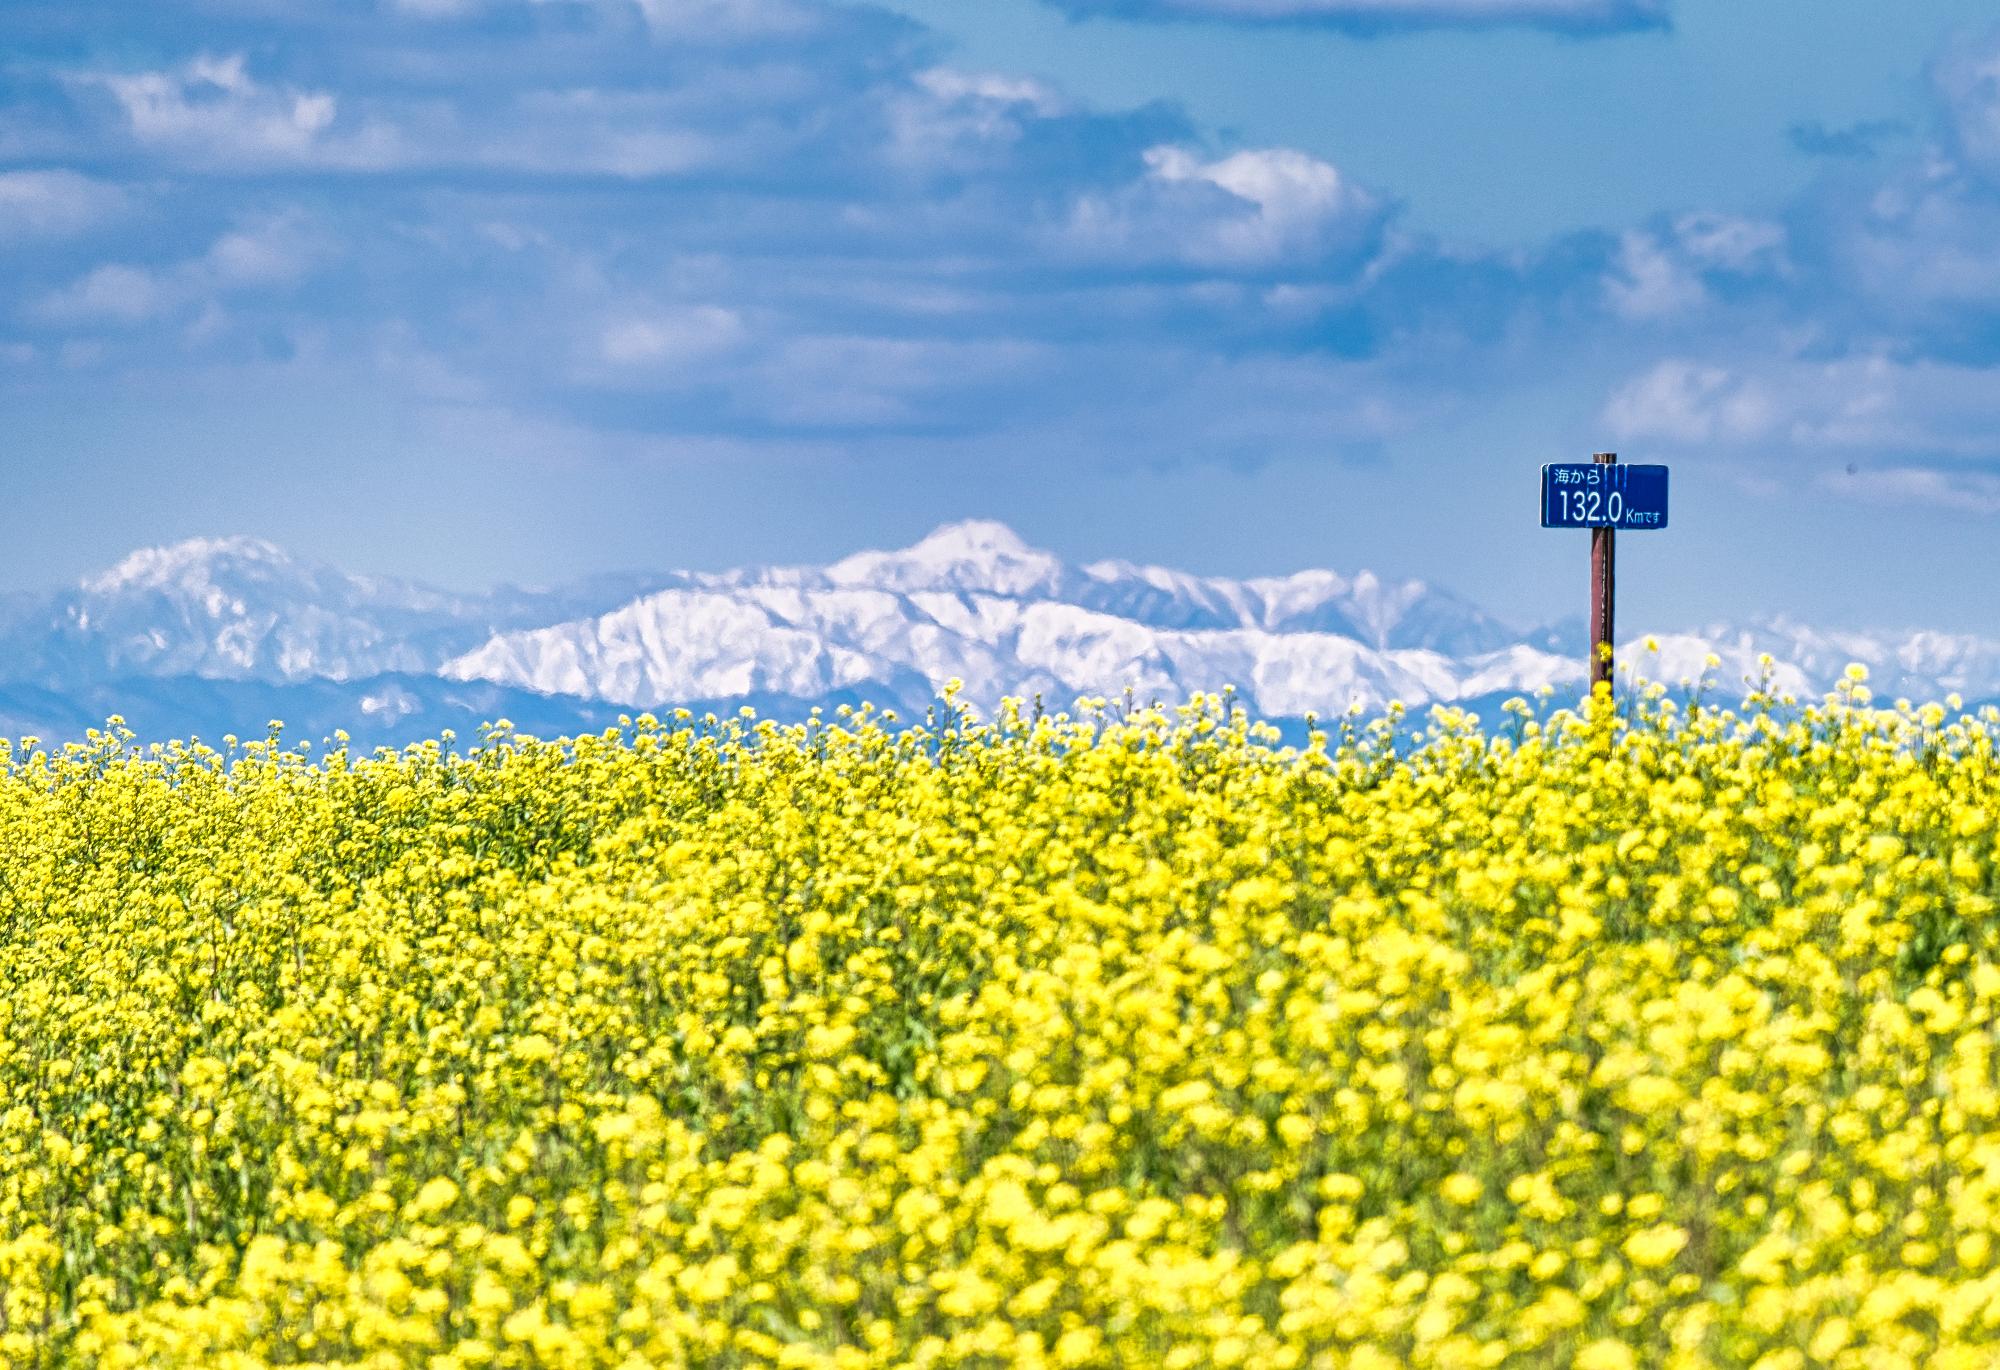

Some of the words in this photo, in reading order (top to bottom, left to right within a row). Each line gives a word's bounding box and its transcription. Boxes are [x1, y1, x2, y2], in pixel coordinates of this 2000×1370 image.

[1554, 468, 1600, 485] 海から
[1560, 490, 1622, 522] 132.0
